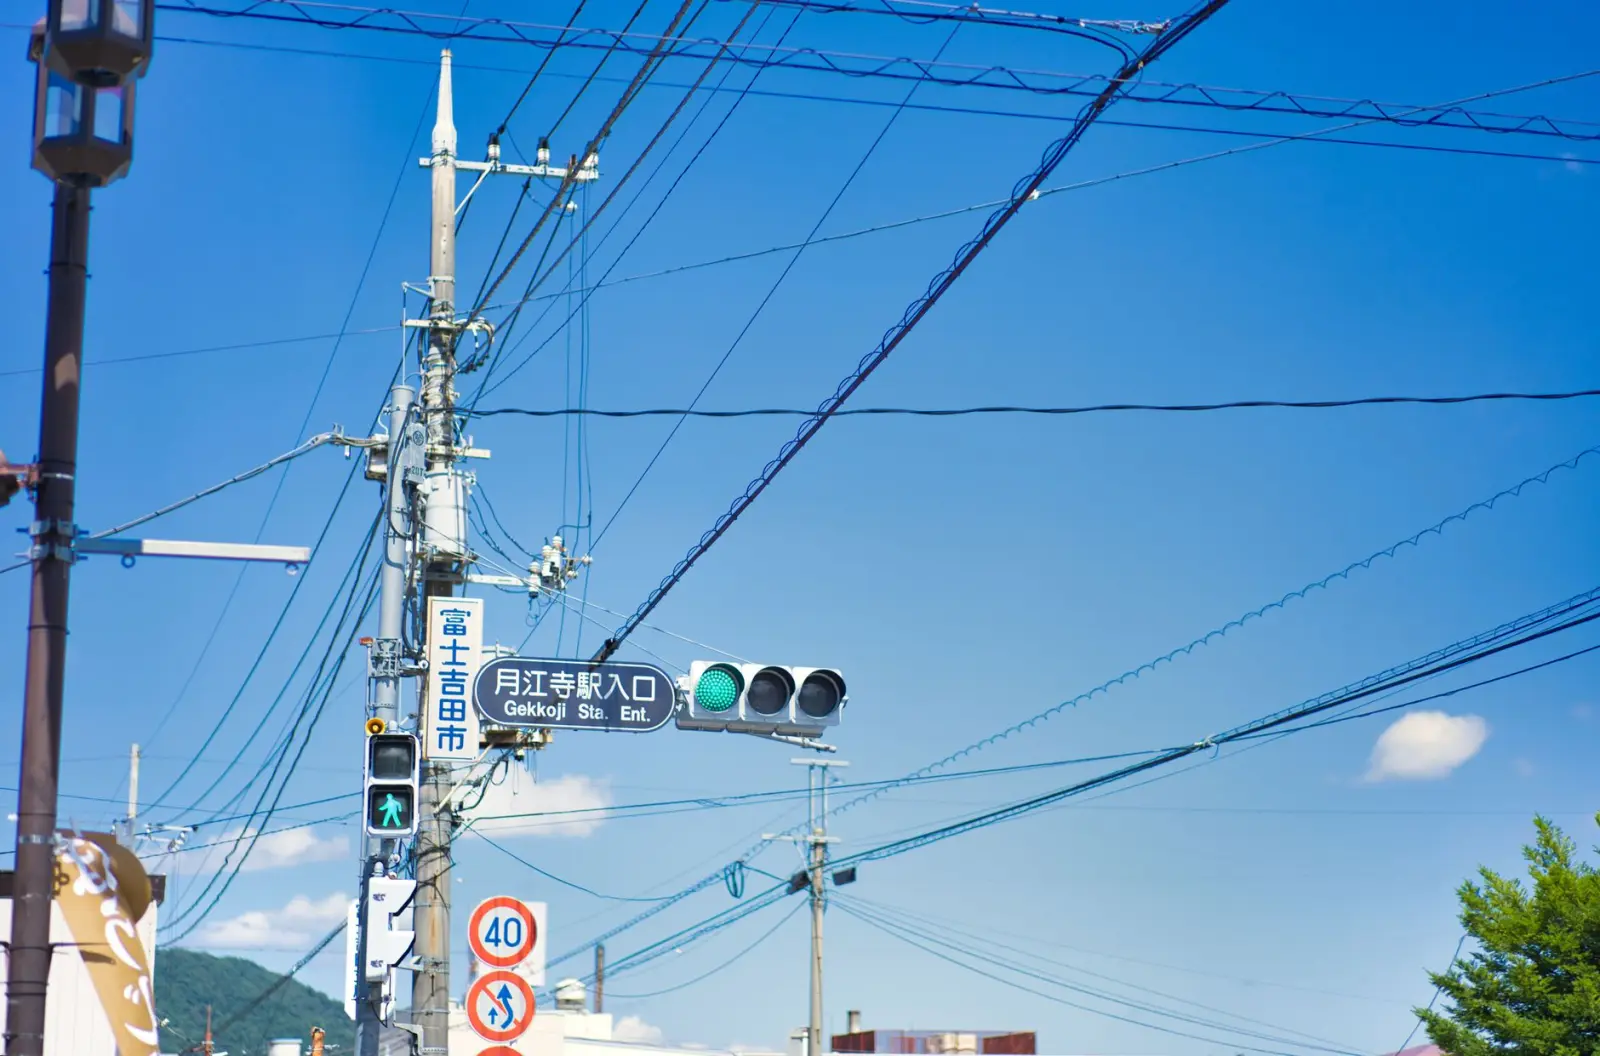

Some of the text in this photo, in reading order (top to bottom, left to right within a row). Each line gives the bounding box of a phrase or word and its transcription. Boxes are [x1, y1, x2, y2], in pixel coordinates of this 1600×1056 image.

[436, 608, 471, 752] 富士吉田市
[495, 668, 656, 702] 月江寺駅入口
[504, 700, 651, 723] Gekkoji Sta. Ent.
[484, 916, 521, 948] 40
